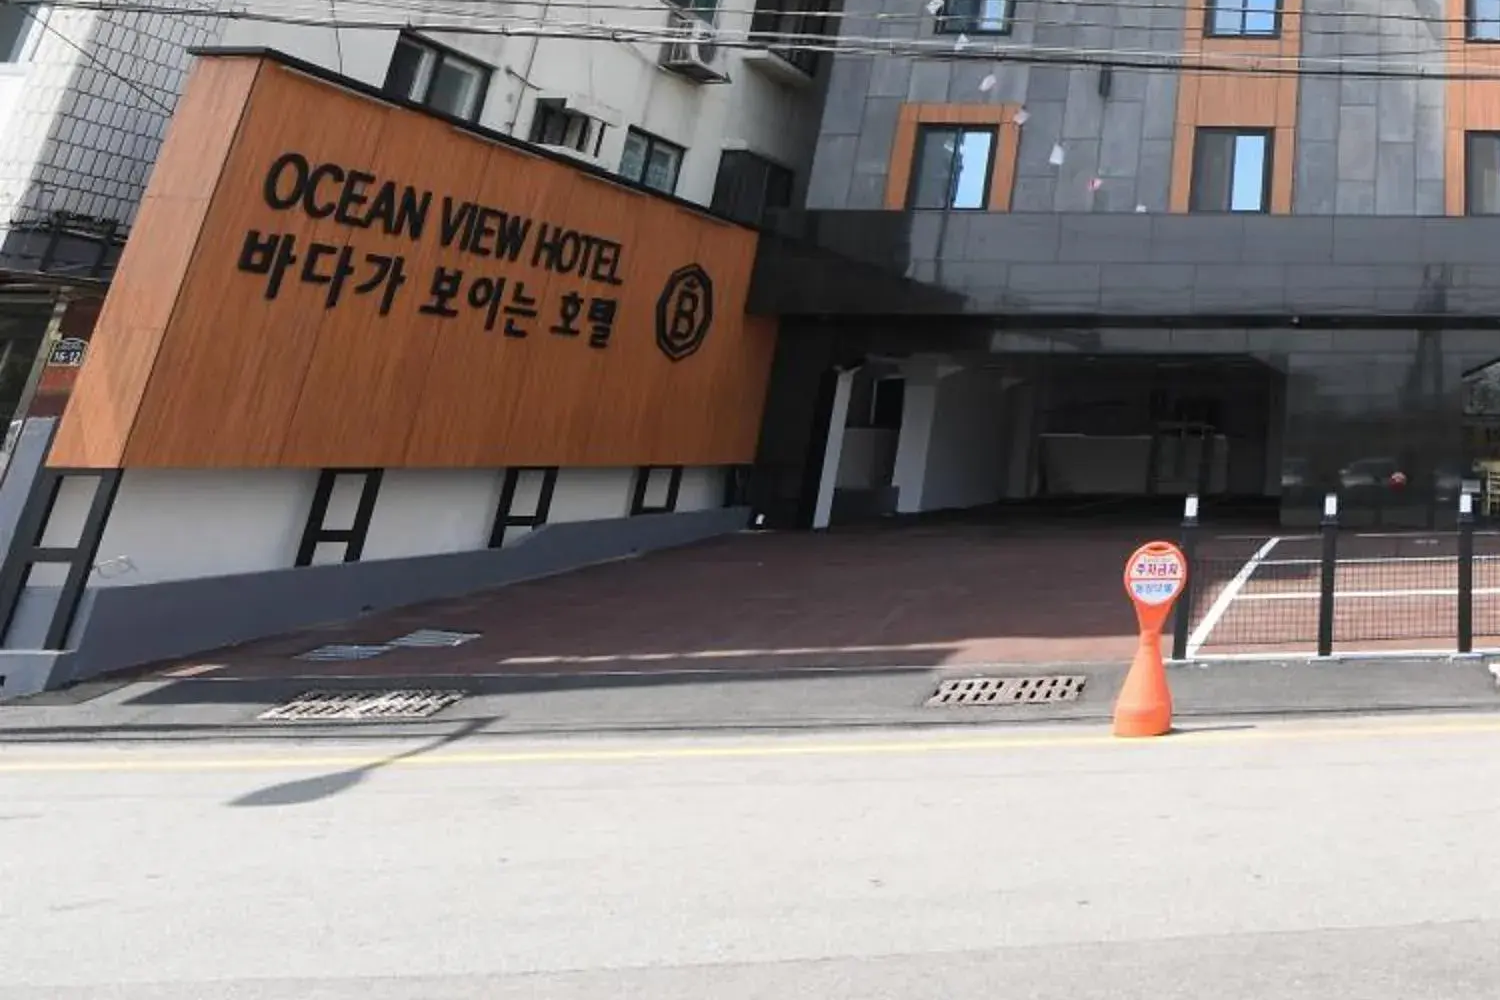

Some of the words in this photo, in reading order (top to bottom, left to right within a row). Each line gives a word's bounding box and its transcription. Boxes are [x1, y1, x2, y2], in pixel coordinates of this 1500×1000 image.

[263, 152, 433, 241] OCEAN
[439, 196, 532, 263] VIEW
[531, 222, 624, 286] HOTEL
[237, 229, 405, 316] 바다가
[418, 265, 538, 338] 보이는
[549, 290, 618, 349] 호텔
